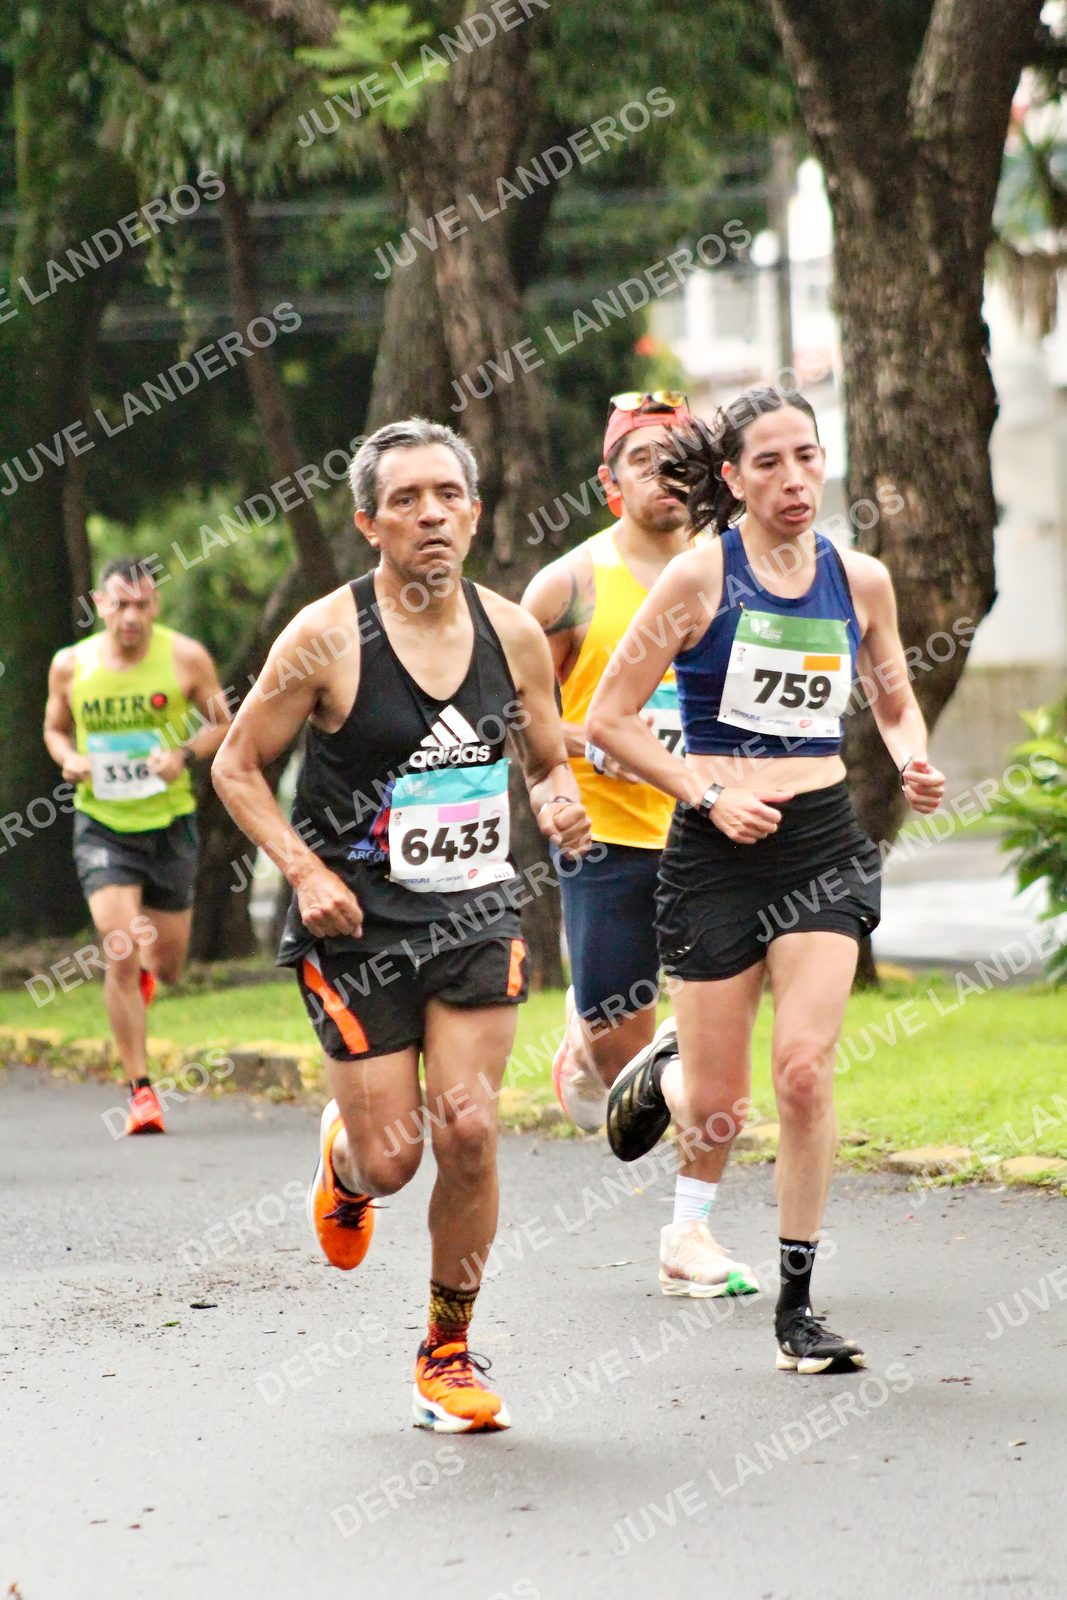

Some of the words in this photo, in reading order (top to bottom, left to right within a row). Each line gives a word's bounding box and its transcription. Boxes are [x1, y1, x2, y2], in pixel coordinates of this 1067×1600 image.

[753, 668, 831, 710] 759
[409, 743, 491, 768] adidas
[658, 729, 687, 759] 7
[402, 817, 500, 866] 6433
